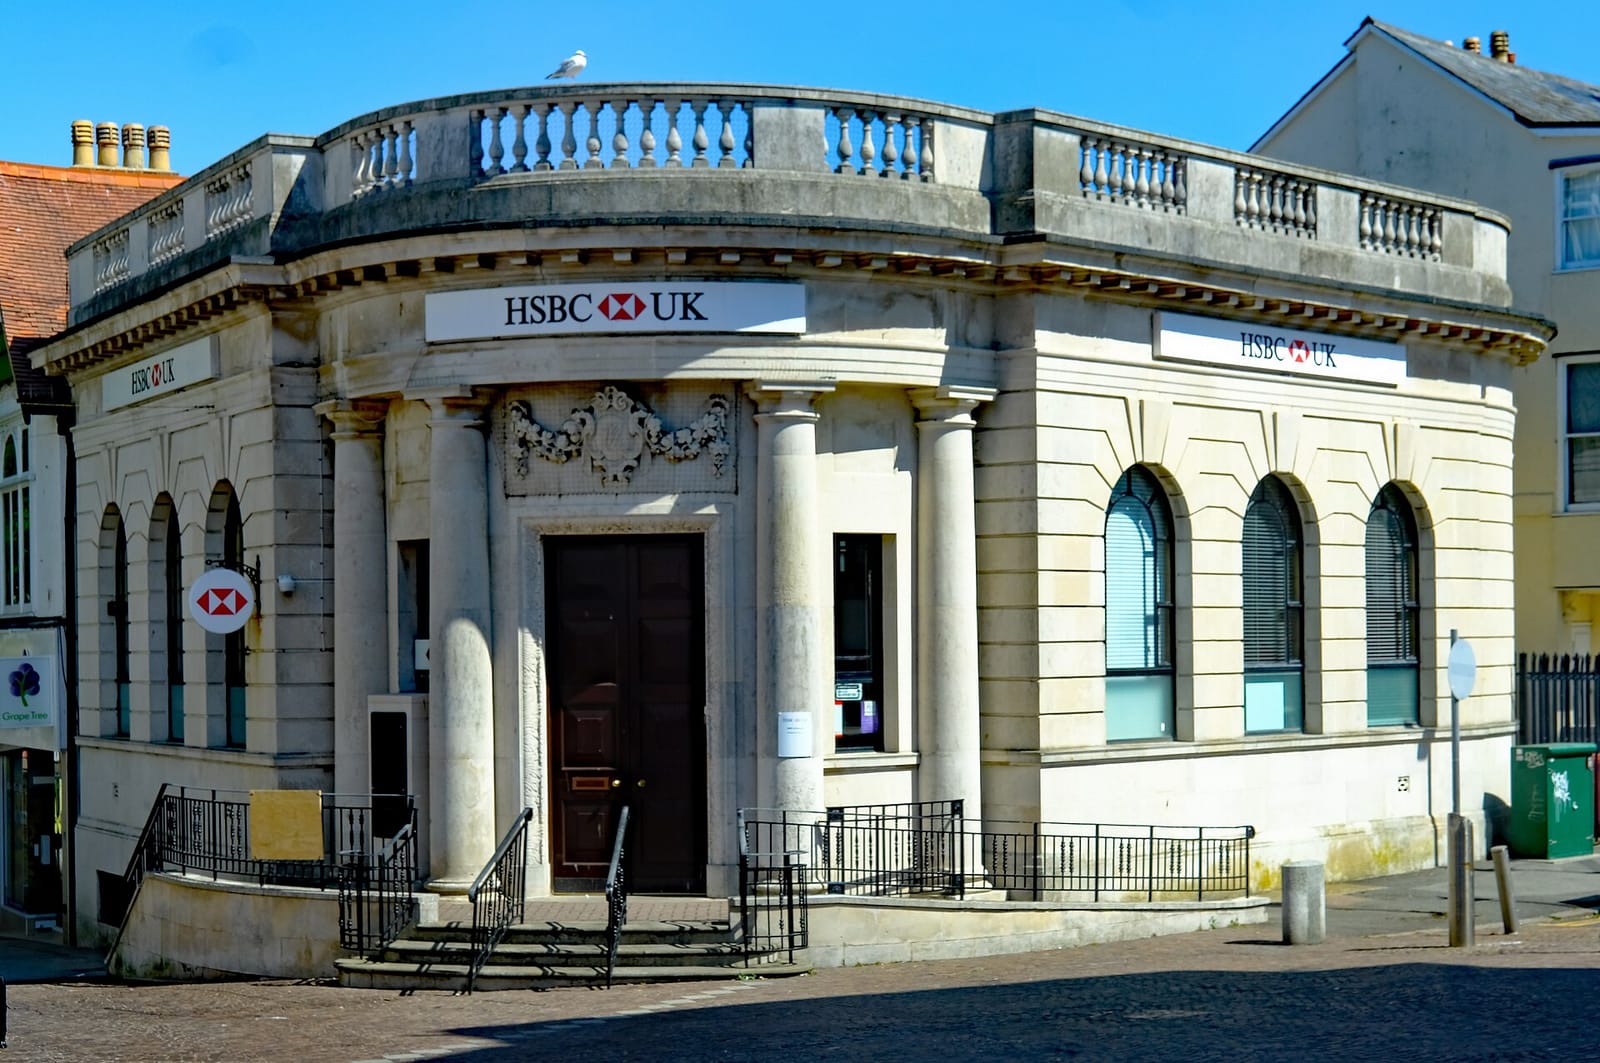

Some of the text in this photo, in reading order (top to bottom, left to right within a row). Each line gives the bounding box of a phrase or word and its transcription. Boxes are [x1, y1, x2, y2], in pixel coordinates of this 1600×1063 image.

[504, 292, 708, 325] HSBC UK
[1240, 332, 1337, 368] HSBC UK
[131, 358, 175, 395] HSBC UK
[2, 711, 29, 721] Grape
[31, 711, 48, 720] Tree
